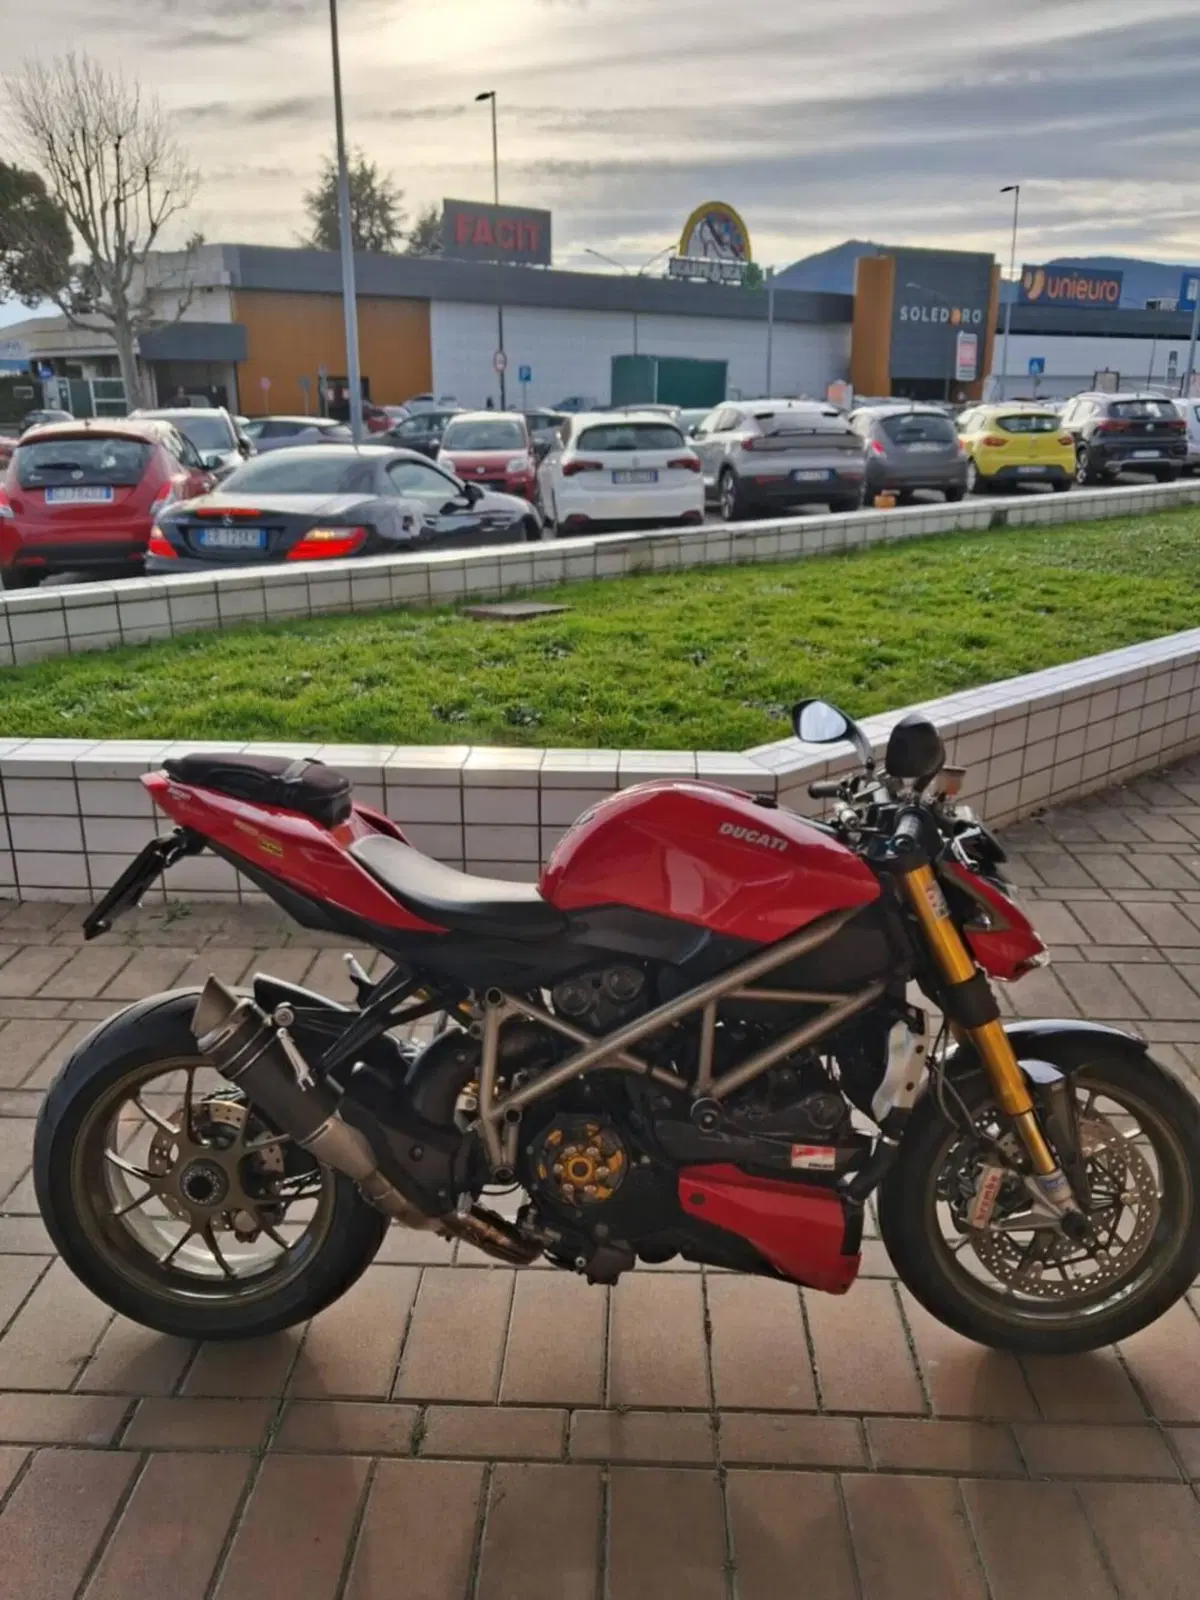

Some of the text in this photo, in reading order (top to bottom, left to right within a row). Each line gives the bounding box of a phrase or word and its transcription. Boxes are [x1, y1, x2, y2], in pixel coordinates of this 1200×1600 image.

[455, 213, 541, 250] FACIT
[1047, 274, 1118, 302] unieuro
[719, 821, 790, 853] DUCATI
